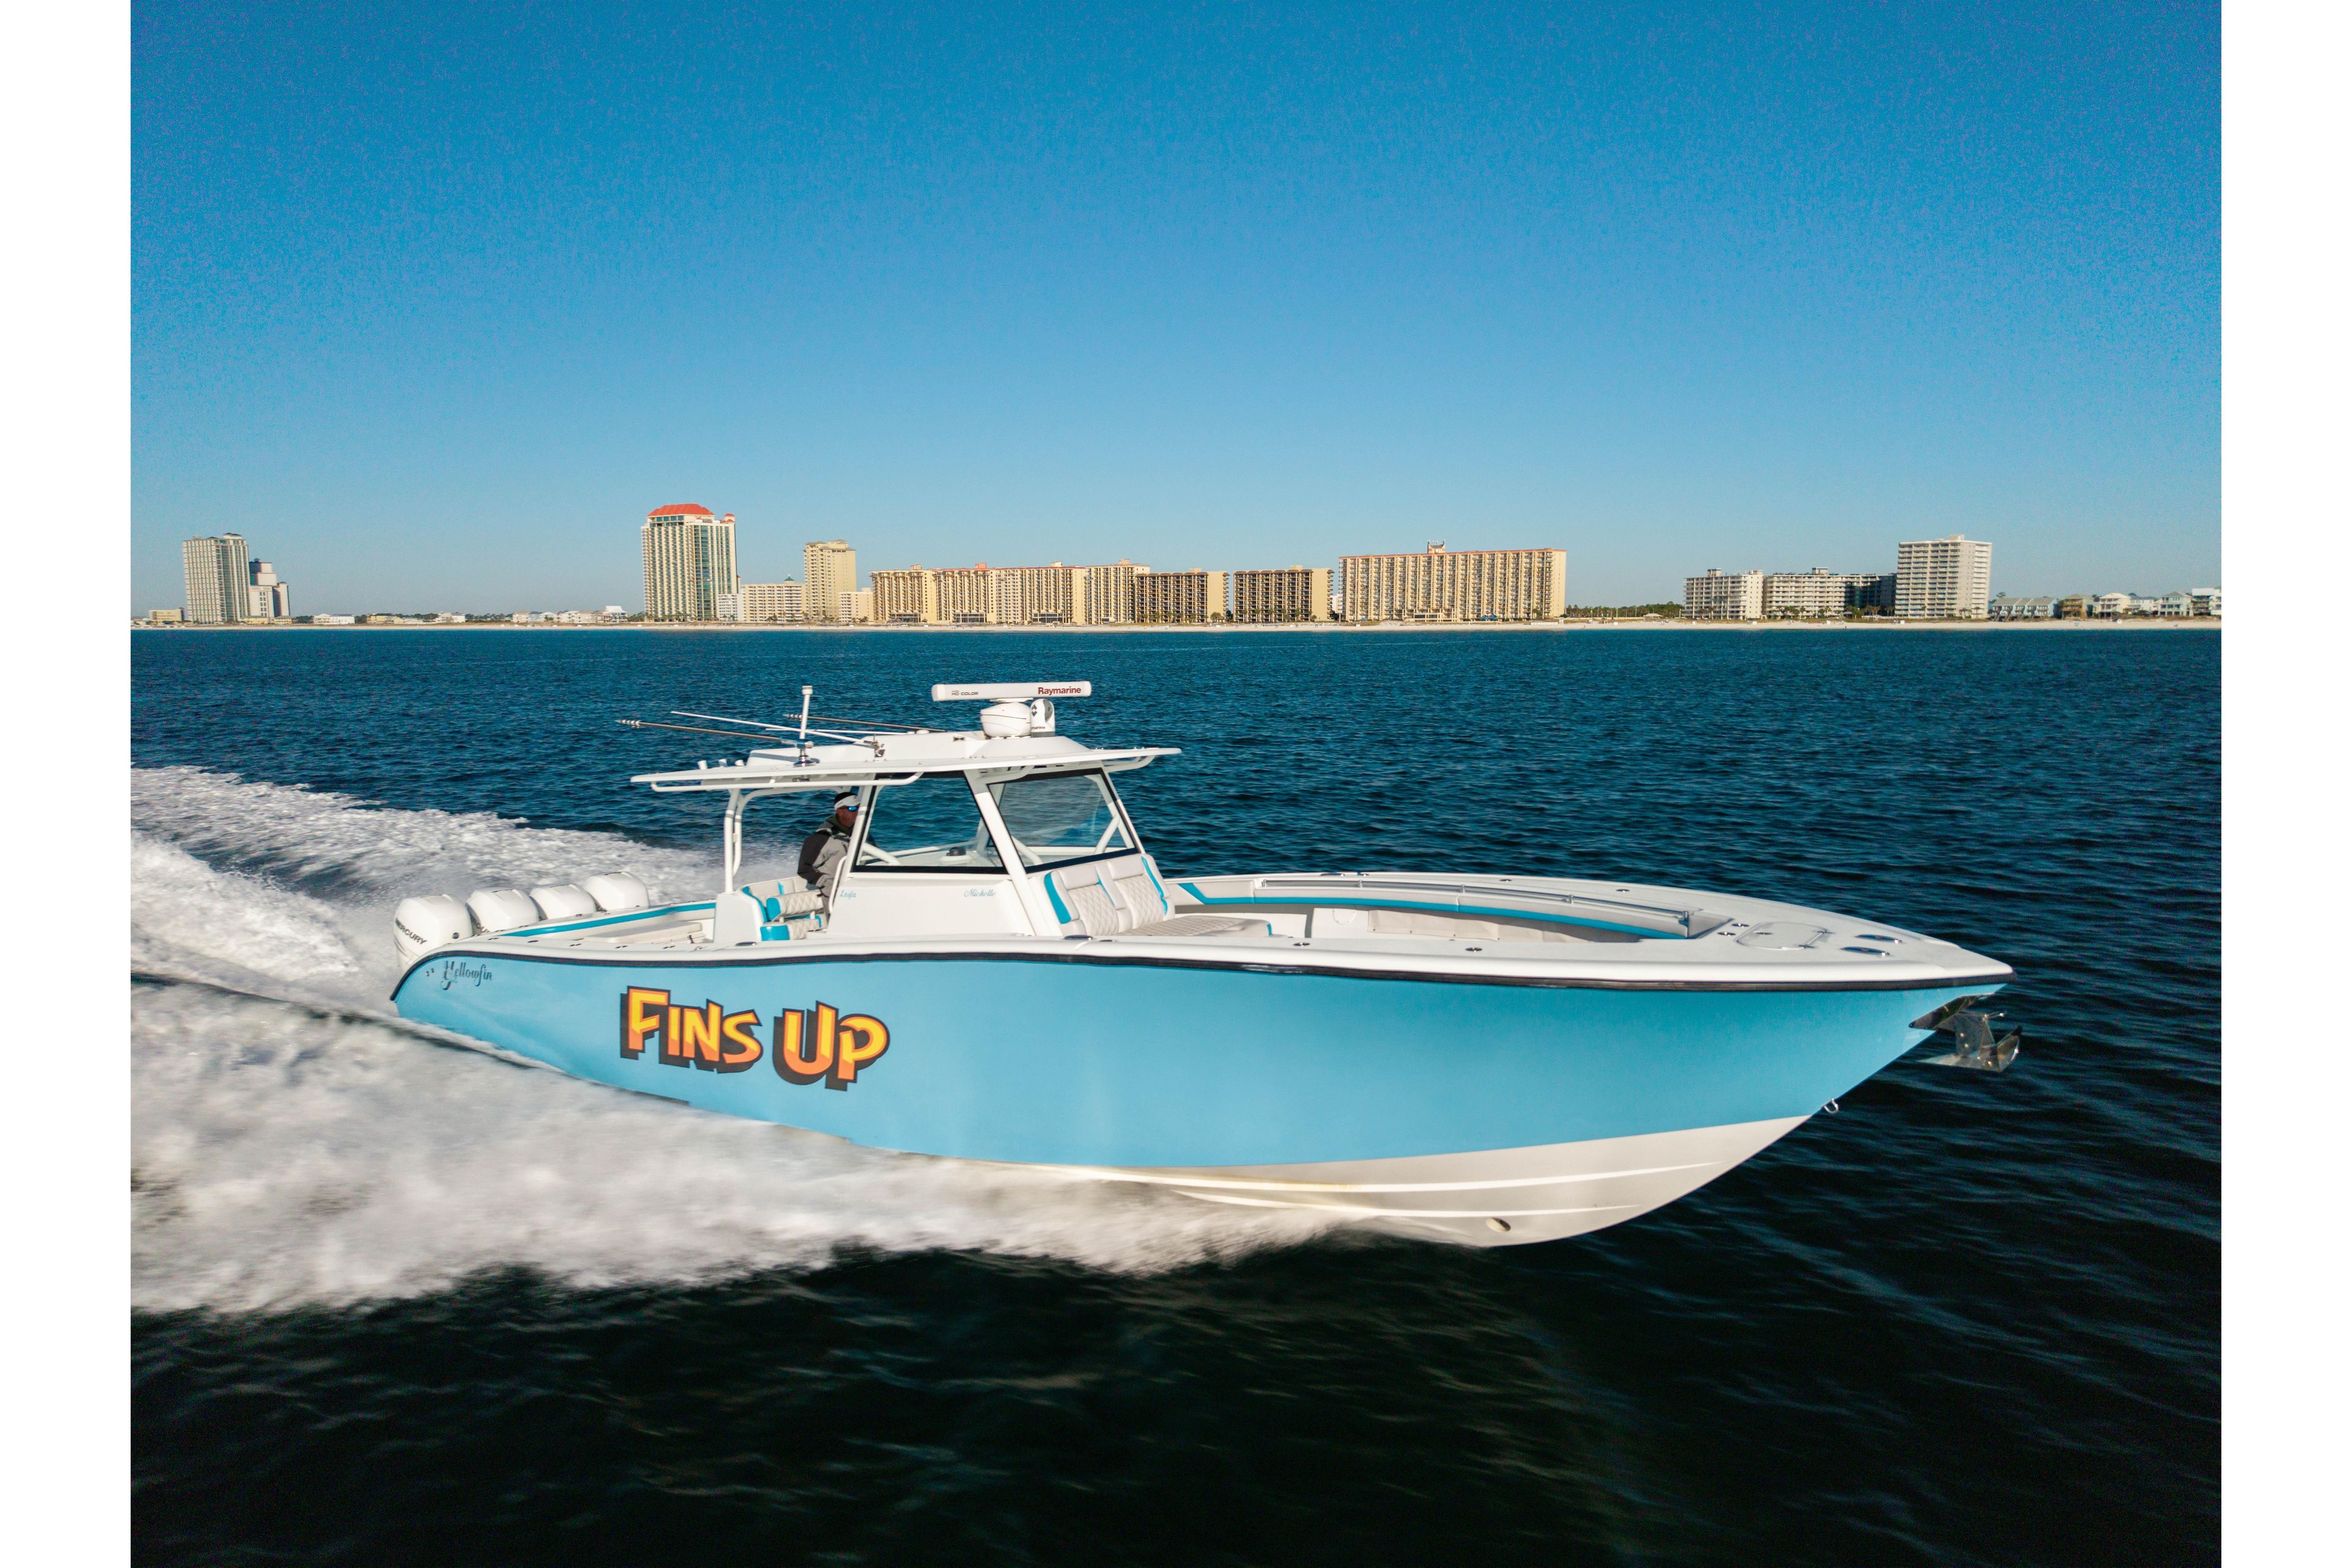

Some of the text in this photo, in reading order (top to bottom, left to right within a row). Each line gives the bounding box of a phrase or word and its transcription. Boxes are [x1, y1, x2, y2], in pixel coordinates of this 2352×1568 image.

[1038, 686, 1082, 696] Raymarine
[395, 917, 428, 944] MERCURY
[440, 960, 492, 990] Yellowfin
[620, 986, 891, 1091] FINS UP
